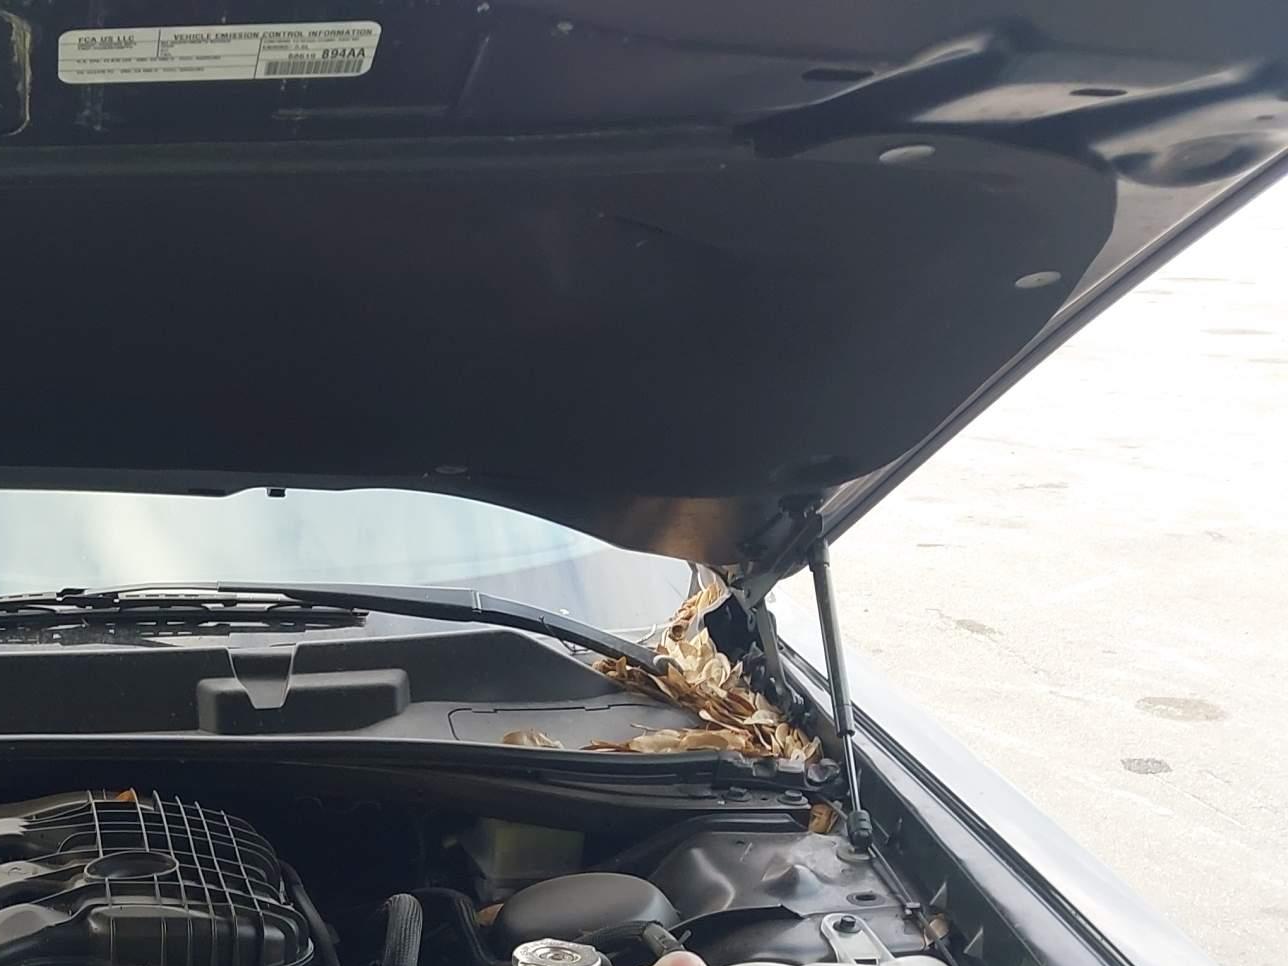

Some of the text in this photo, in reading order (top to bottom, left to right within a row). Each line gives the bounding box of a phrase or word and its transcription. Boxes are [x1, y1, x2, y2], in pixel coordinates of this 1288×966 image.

[174, 27, 372, 41] VEHICLE EMISSION CONTROL INFORMATION
[321, 47, 366, 60] 894AA
